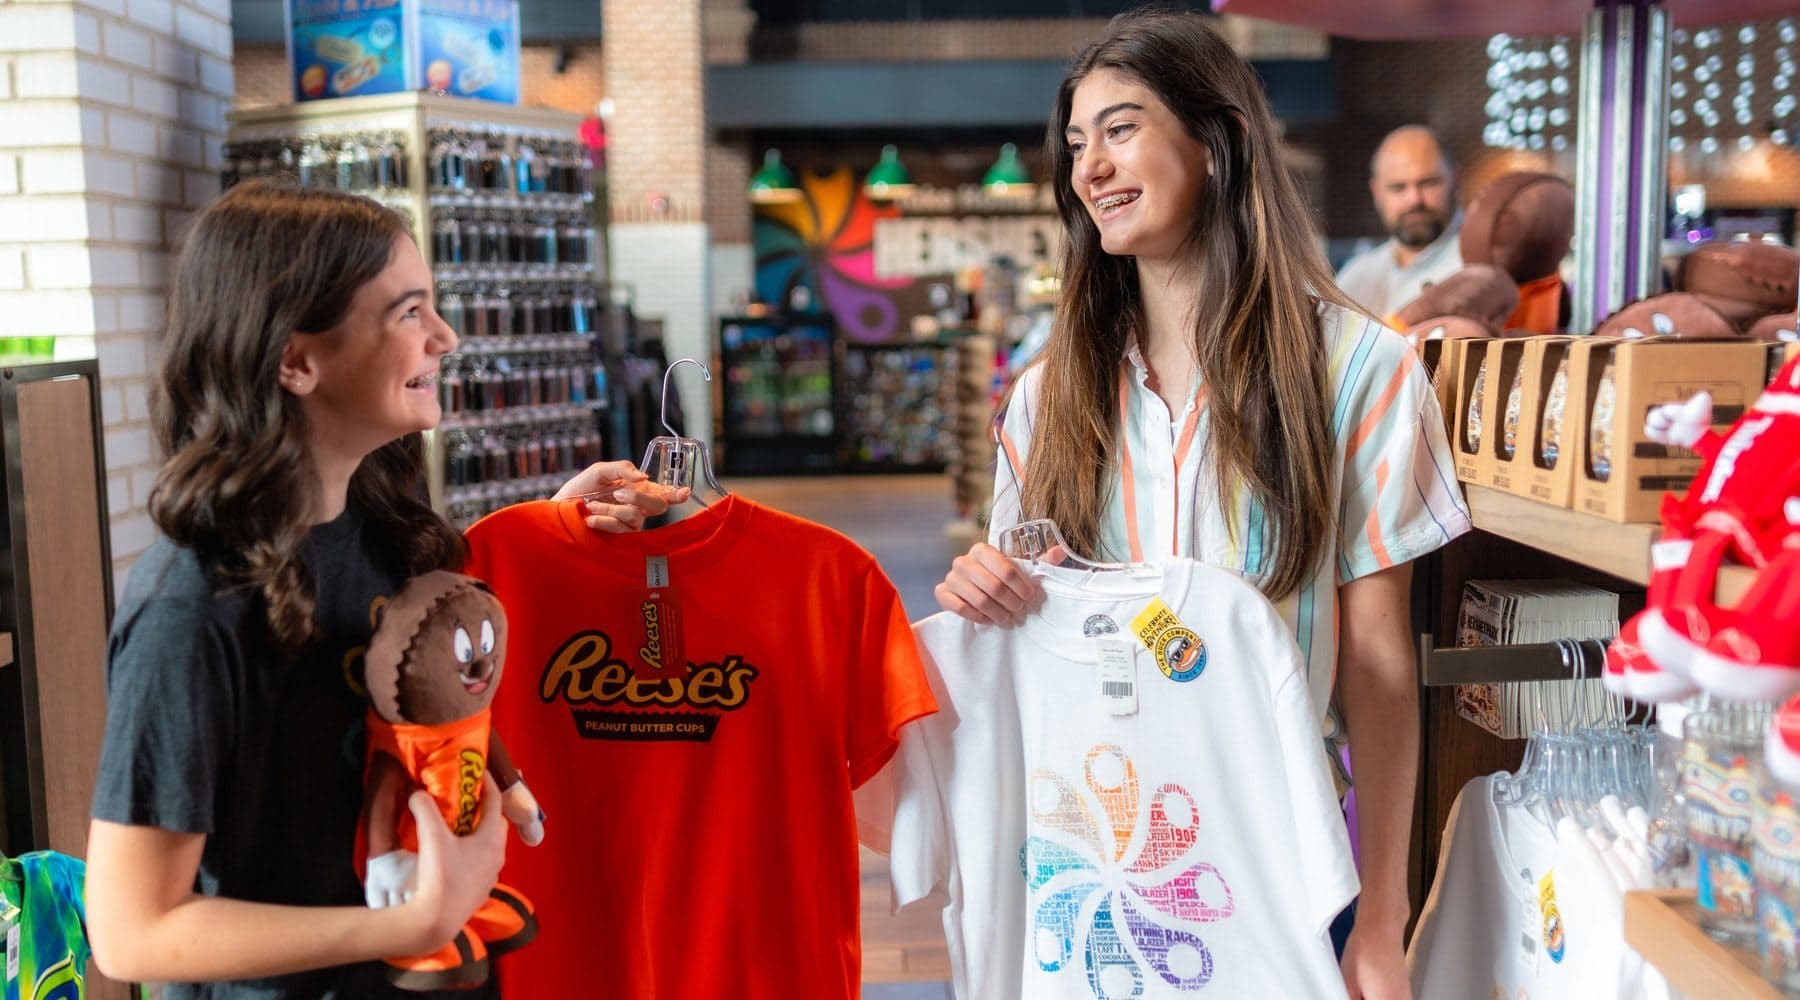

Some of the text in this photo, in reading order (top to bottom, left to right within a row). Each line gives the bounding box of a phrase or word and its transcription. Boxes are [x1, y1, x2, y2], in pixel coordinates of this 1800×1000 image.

[1139, 608, 1168, 638] CELEBRATE
[639, 601, 663, 670] Reese's
[1157, 637, 1168, 656] DUCK
[540, 631, 757, 709] Reese's
[585, 721, 705, 734] PEANUT BUTTER CUPS
[1170, 828, 1198, 843] 1906
[1175, 888, 1200, 900] 1906
